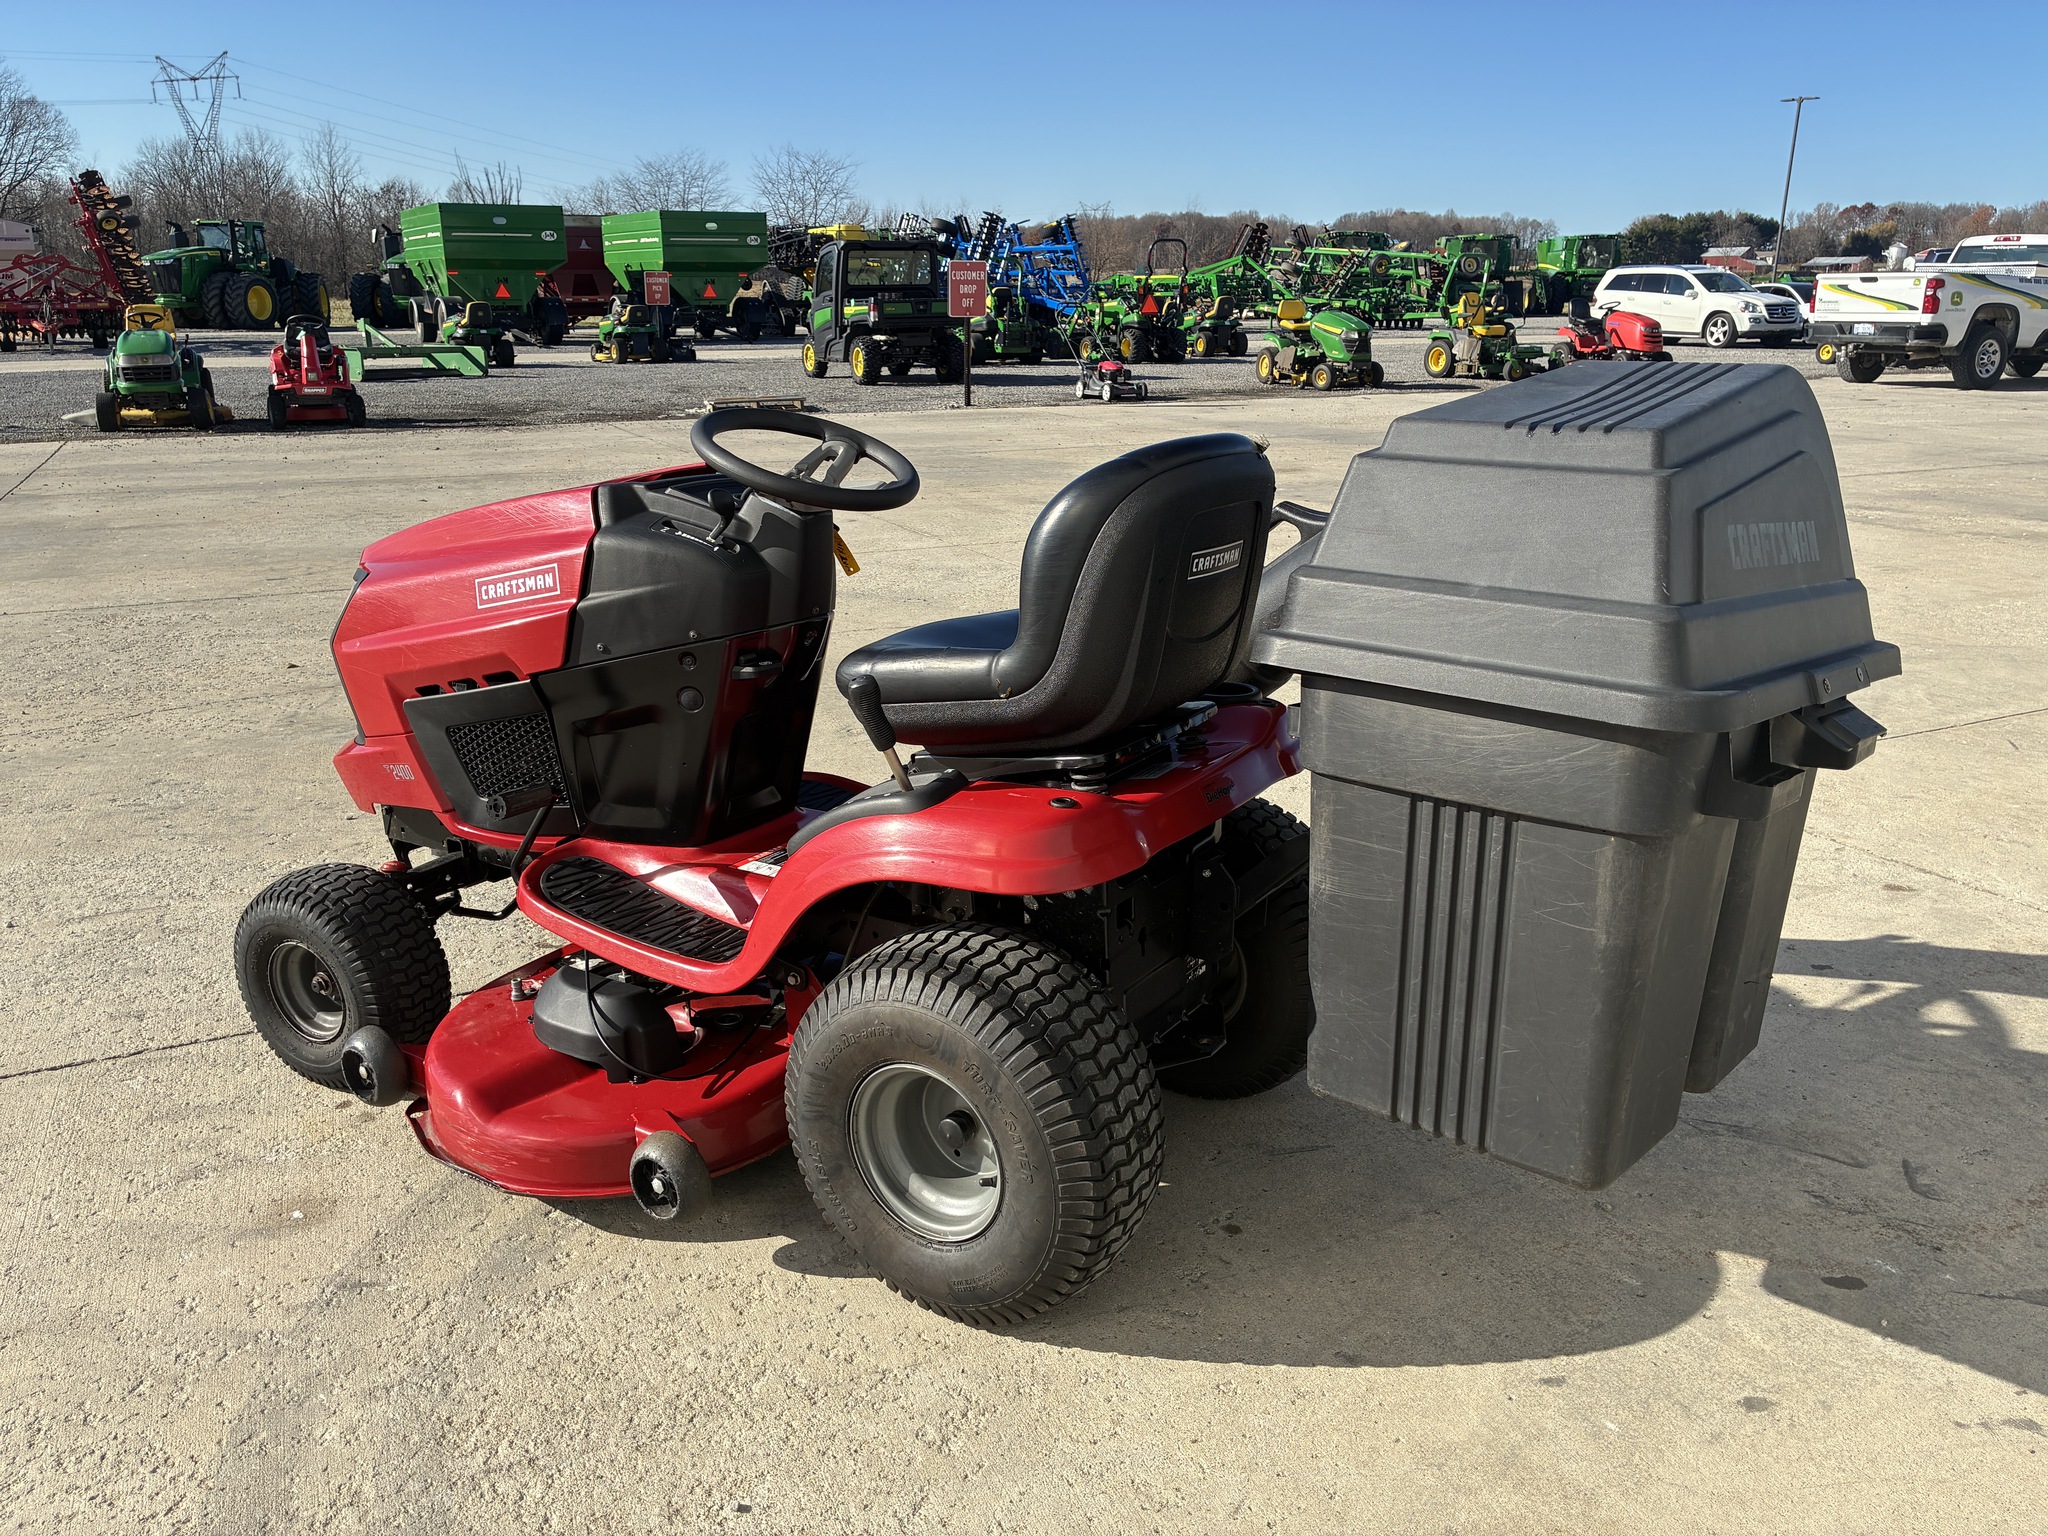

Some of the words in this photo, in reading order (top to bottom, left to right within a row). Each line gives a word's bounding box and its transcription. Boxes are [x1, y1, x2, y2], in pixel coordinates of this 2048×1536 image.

[951, 271, 985, 280] CUSTOMER
[959, 284, 977, 294] DROP
[961, 298, 974, 307] OFF
[1728, 520, 1820, 570] CRAFTSMAN
[1192, 547, 1240, 573] CRAFTSMAN
[481, 572, 554, 600] CRAFTSMAN
